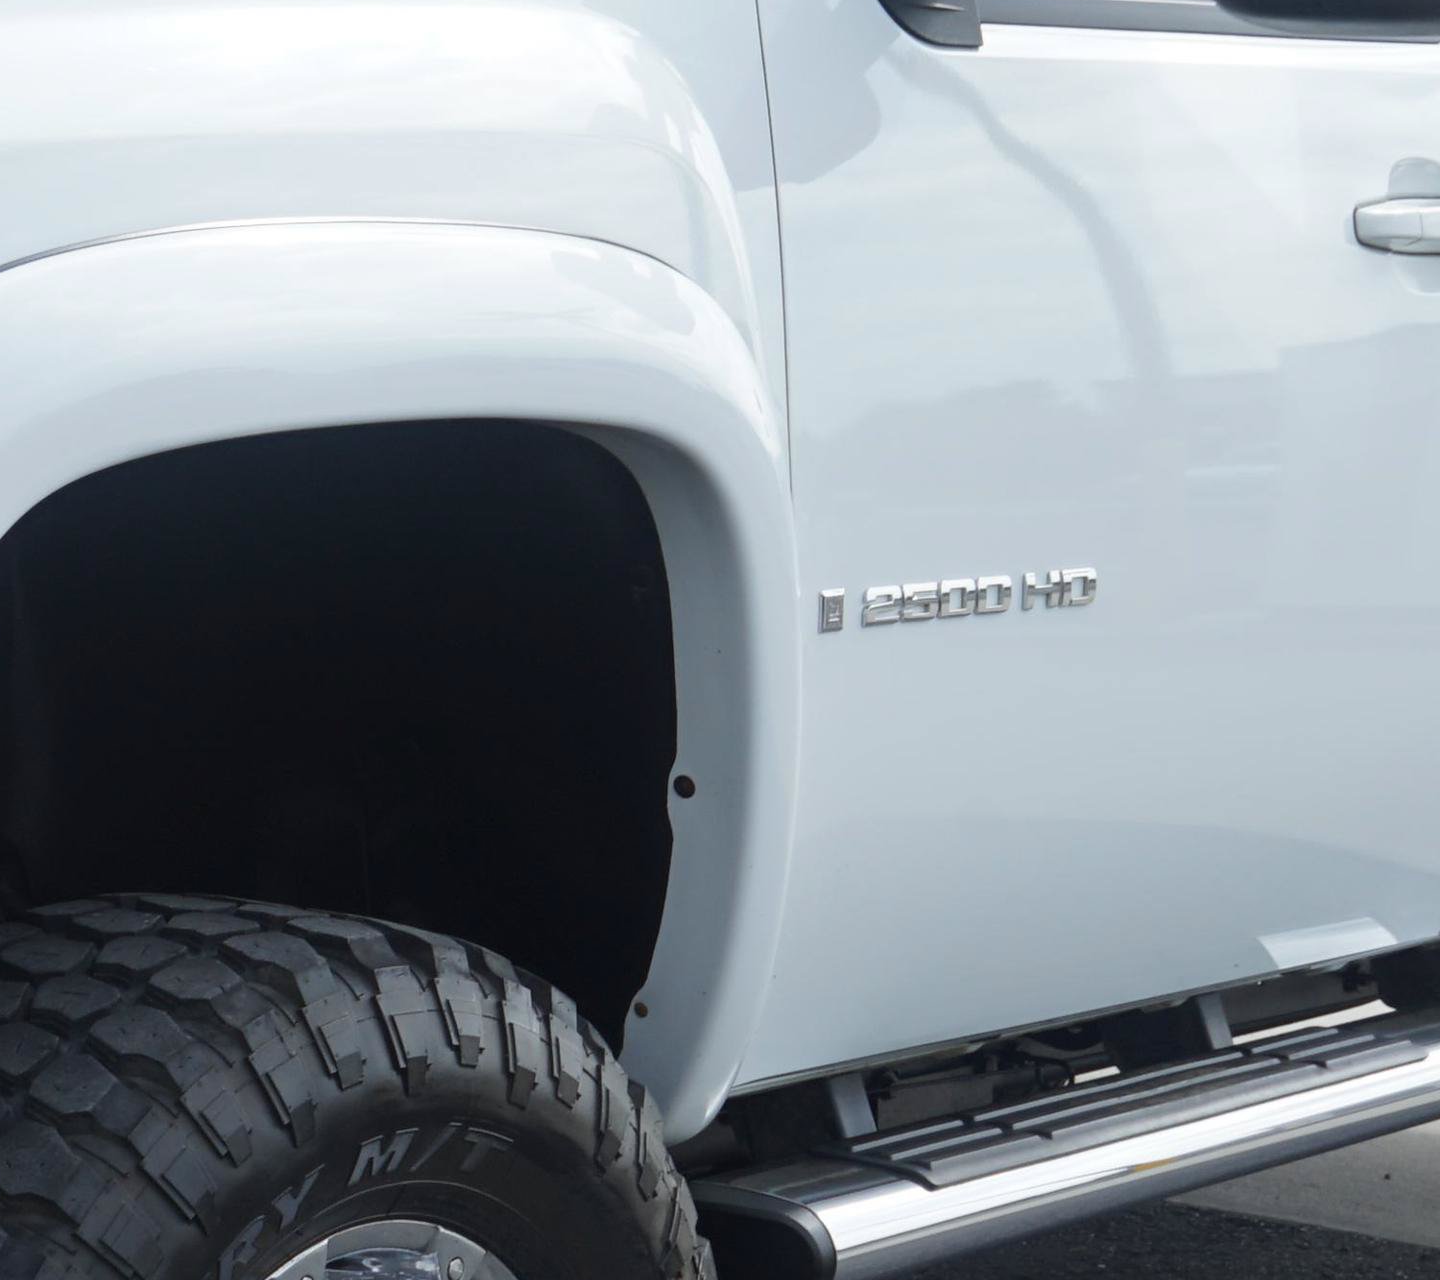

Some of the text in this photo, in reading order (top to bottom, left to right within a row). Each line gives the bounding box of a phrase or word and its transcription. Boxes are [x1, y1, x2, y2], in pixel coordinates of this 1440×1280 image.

[861, 567, 1098, 627] 2500 HD
[347, 1121, 516, 1187] M/T
